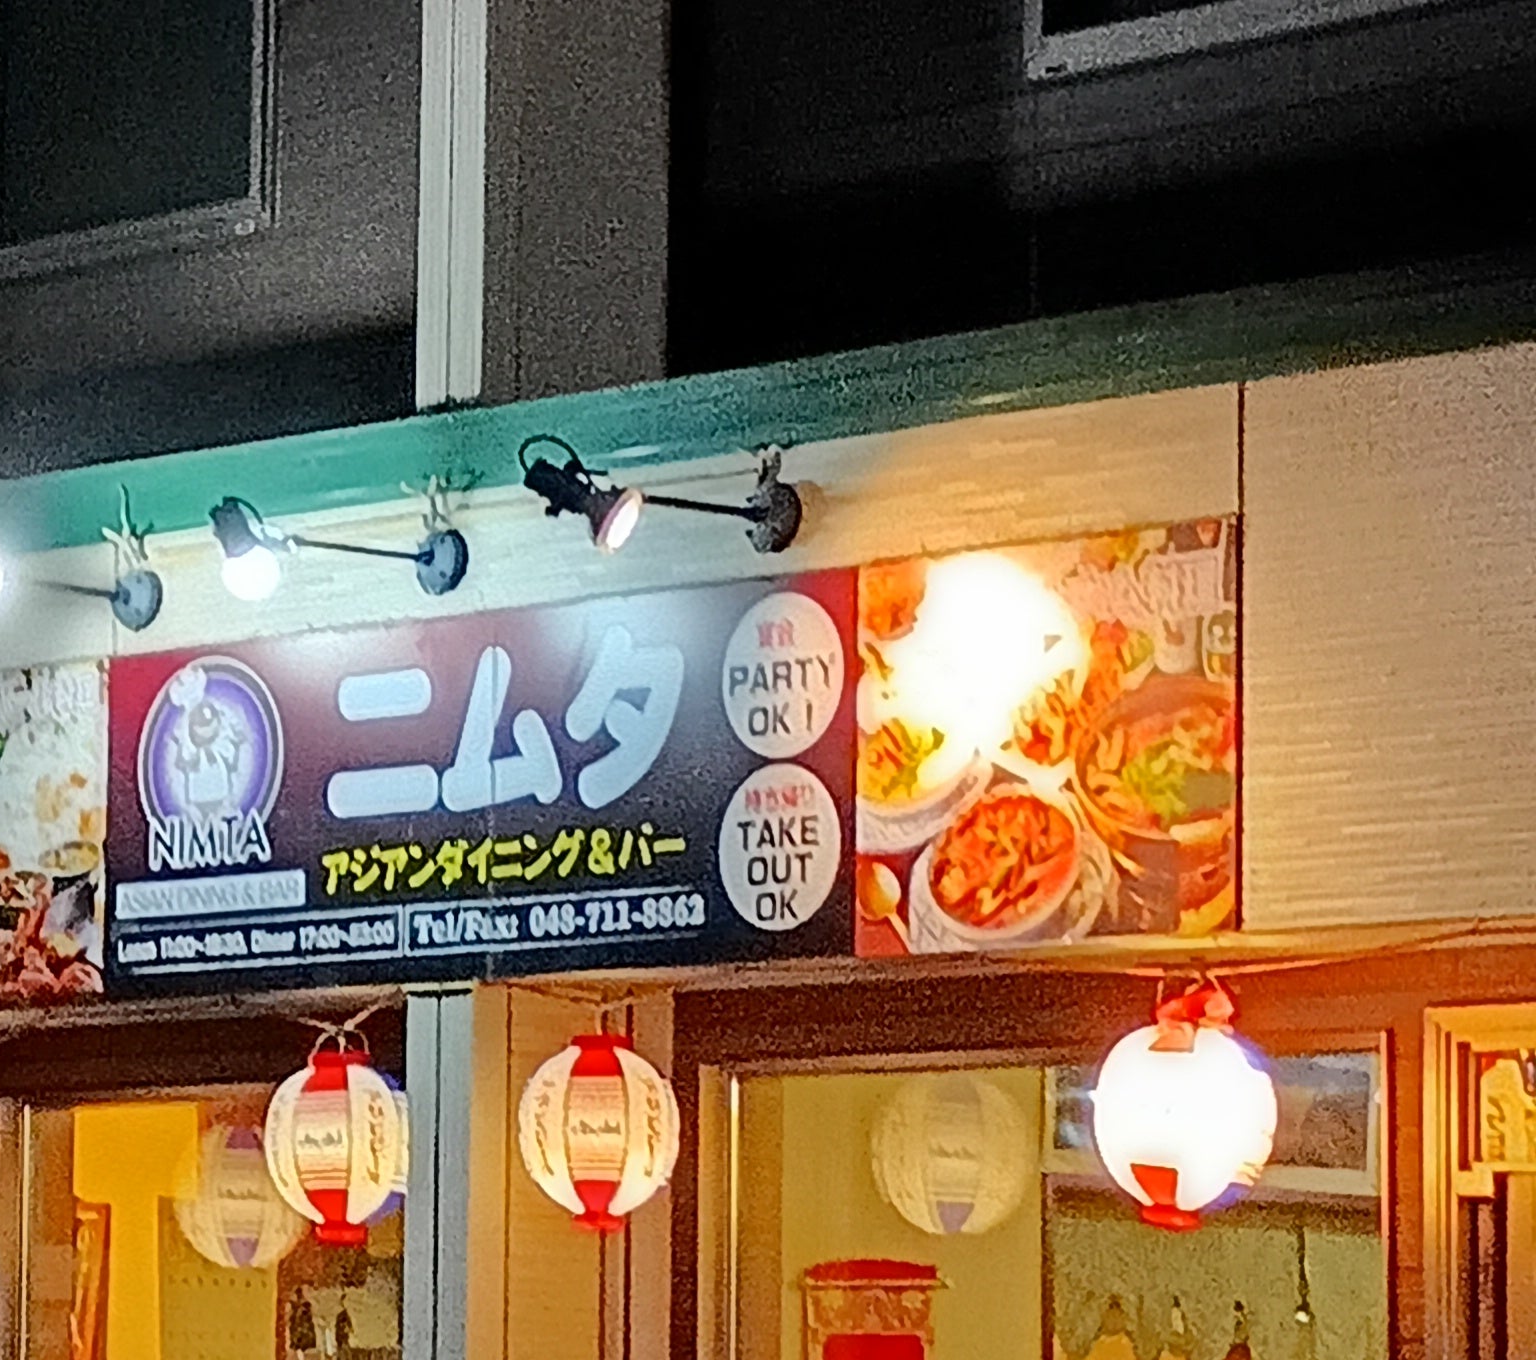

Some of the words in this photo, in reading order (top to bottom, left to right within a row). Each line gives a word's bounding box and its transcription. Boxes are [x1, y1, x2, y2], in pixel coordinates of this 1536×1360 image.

[728, 651, 836, 697] PARTY
[326, 624, 685, 819] ニムタ
[148, 807, 272, 872] NIMTA
[737, 815, 821, 852] TAKE
[747, 853, 813, 886] OUT
[756, 890, 799, 921] OK
